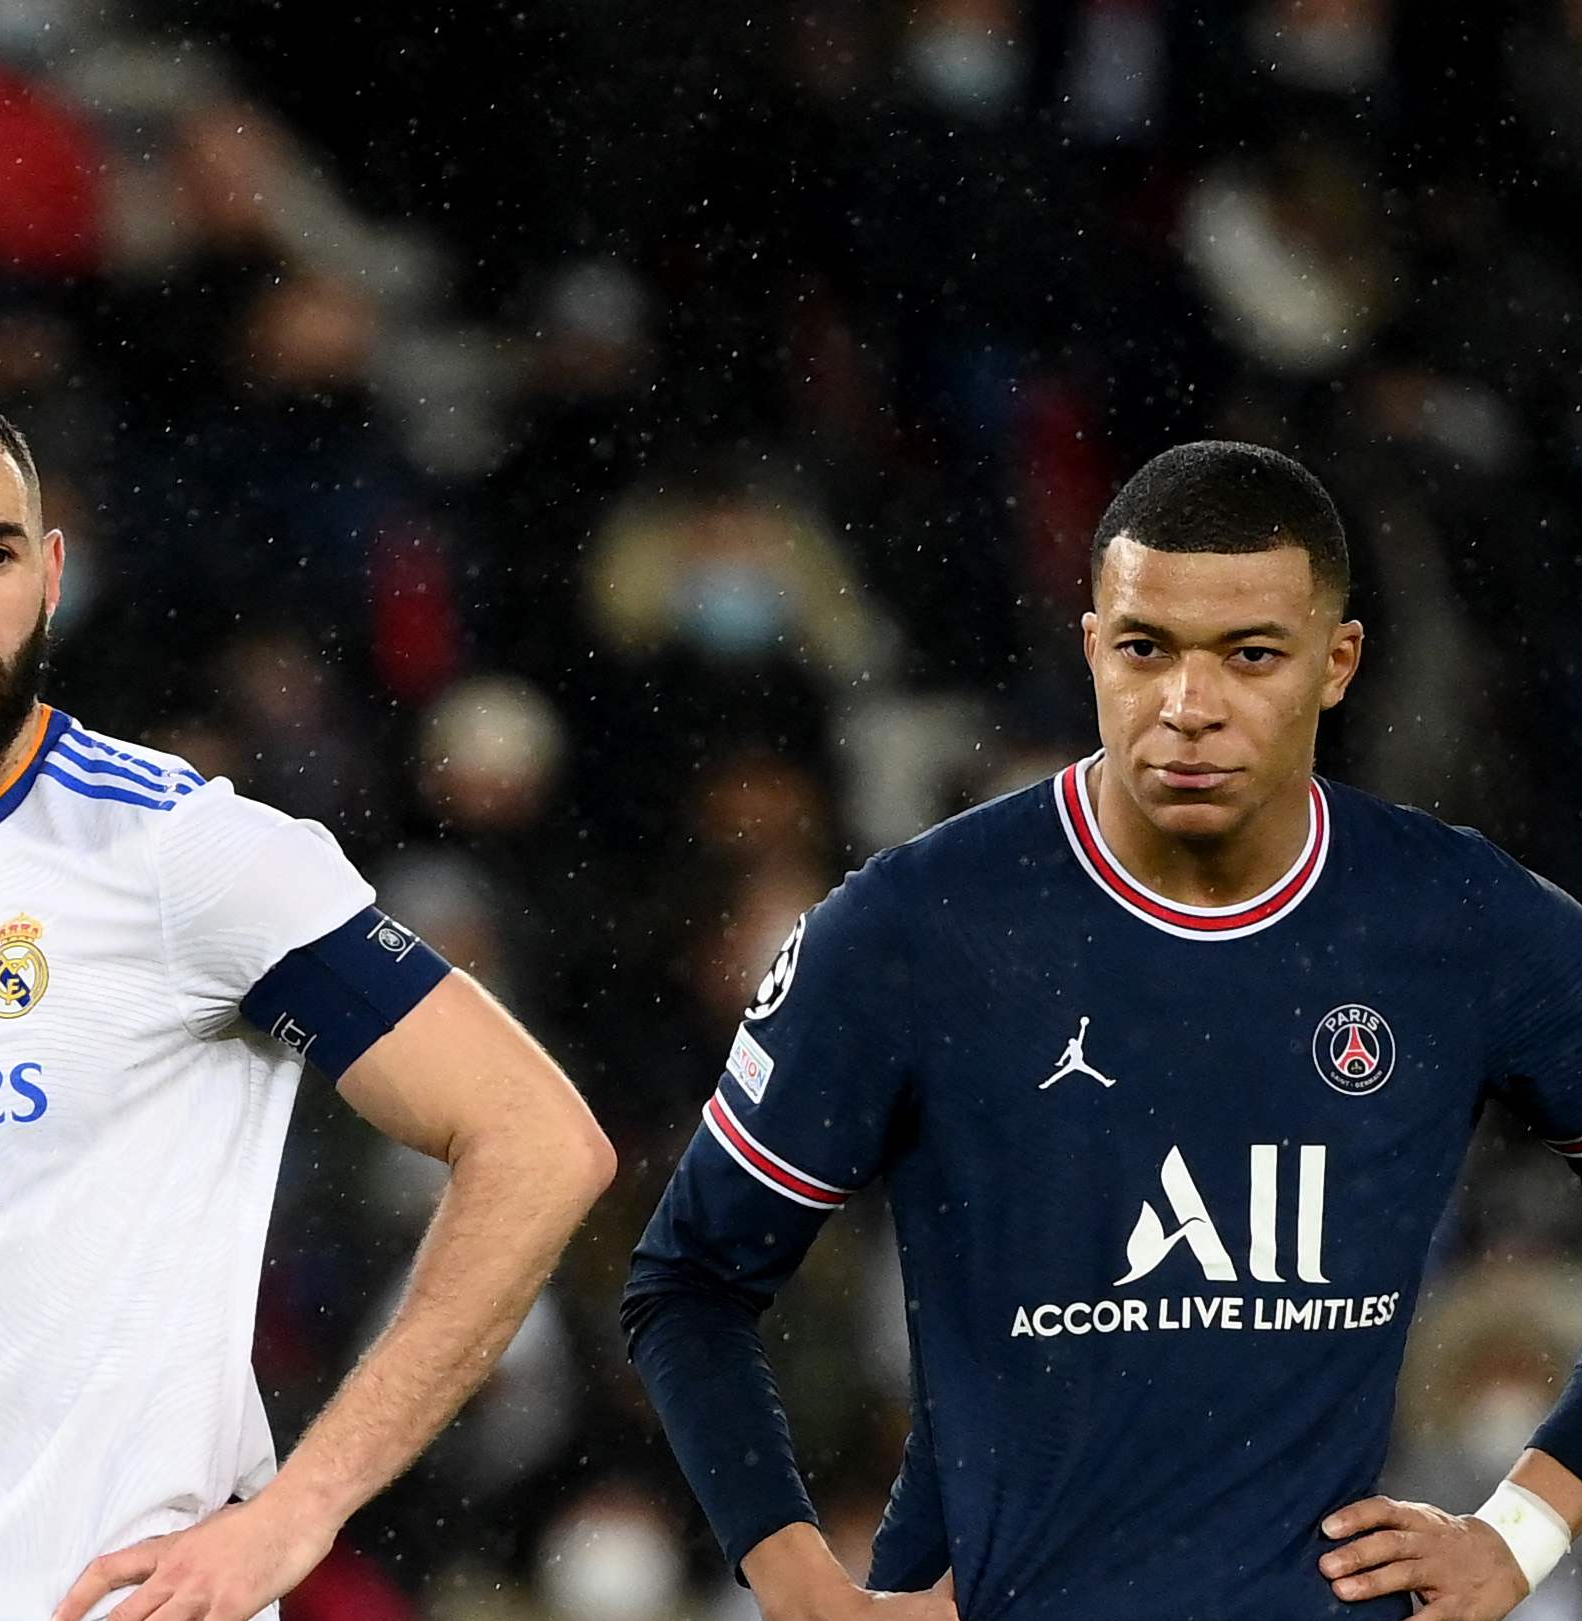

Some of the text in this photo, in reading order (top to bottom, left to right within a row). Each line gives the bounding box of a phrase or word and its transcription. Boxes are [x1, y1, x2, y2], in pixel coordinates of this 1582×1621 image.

[1324, 1008, 1380, 1032] PARIS
[1112, 1144, 1331, 1287] All
[1010, 1291, 1400, 1338] ACCOR LIVE LIMITLESS
